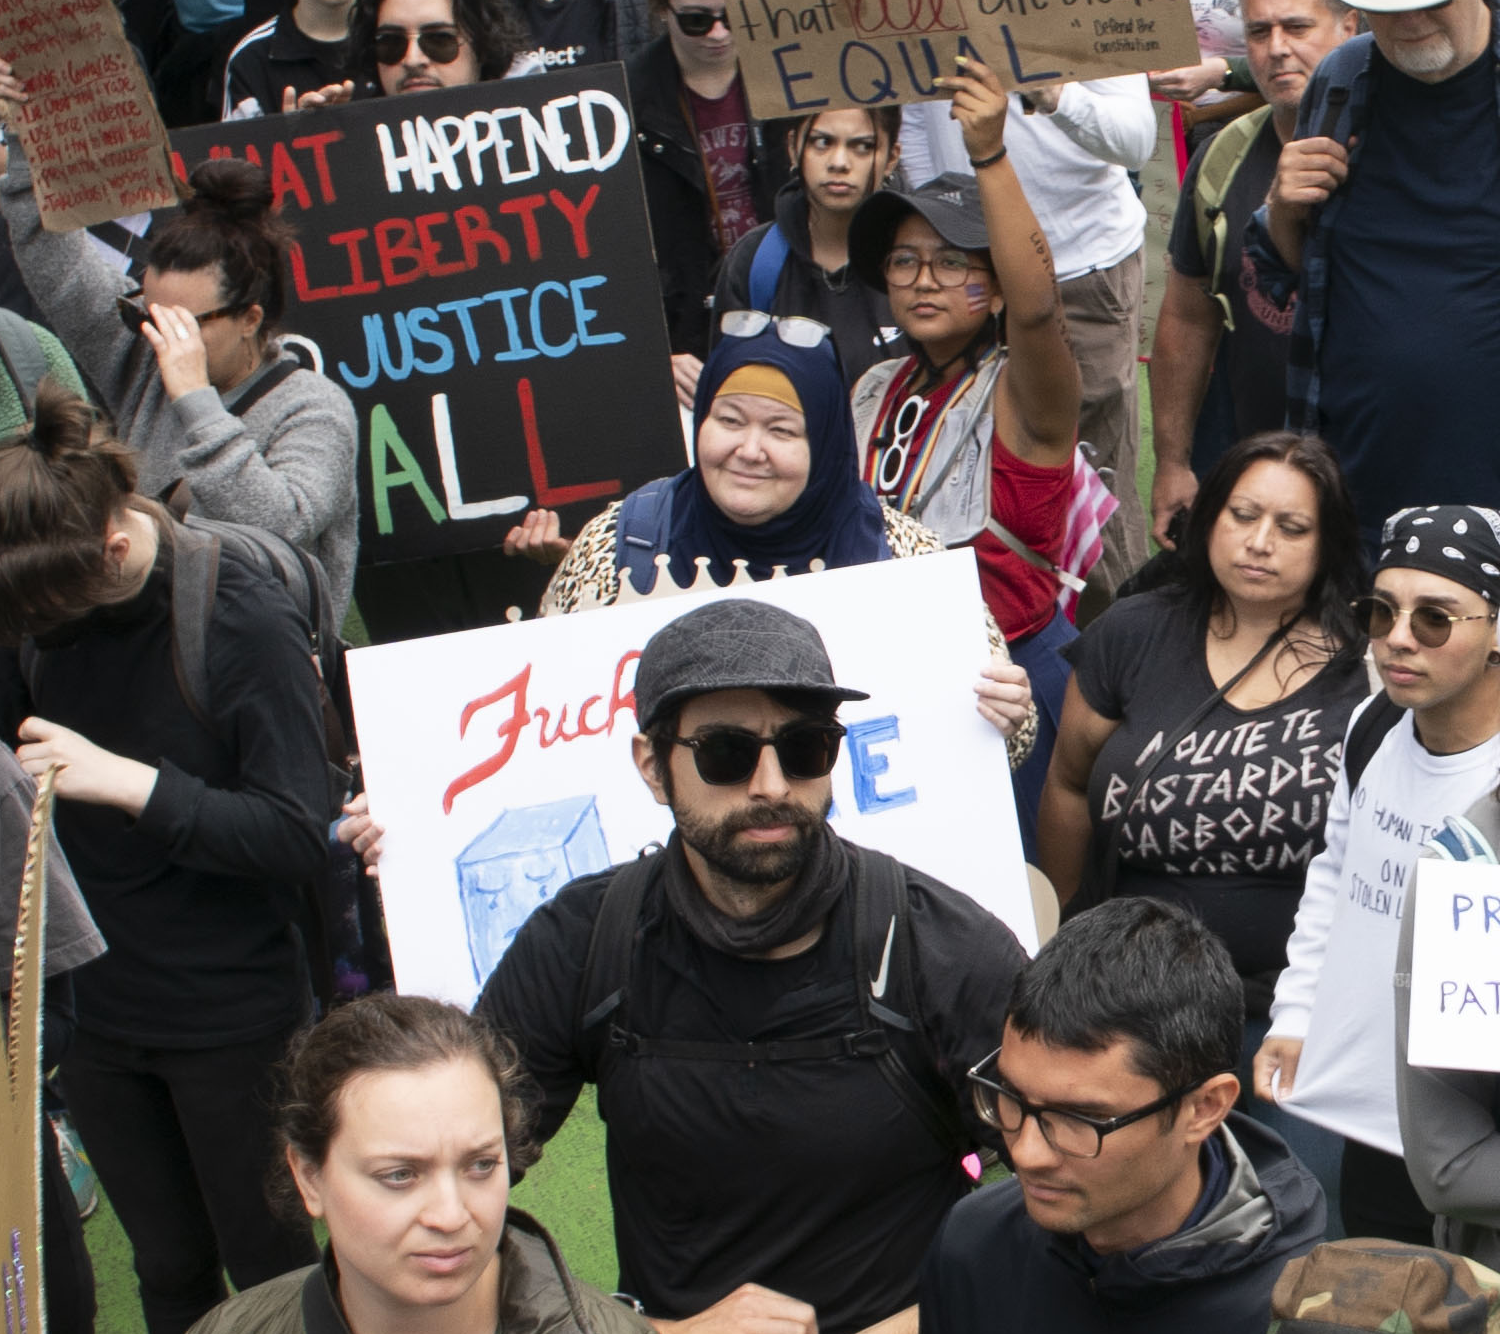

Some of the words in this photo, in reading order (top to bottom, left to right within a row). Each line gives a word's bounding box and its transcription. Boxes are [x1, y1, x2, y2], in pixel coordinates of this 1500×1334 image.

[376, 89, 630, 193] HAPPENED
[289, 184, 600, 301] LIBERTY
[338, 275, 626, 388] JUSTICE
[369, 377, 622, 535] ALL
[1281, 709, 1323, 743] TE
[1373, 800, 1411, 841] HUMAN
[1349, 874, 1391, 916] STOLEN
